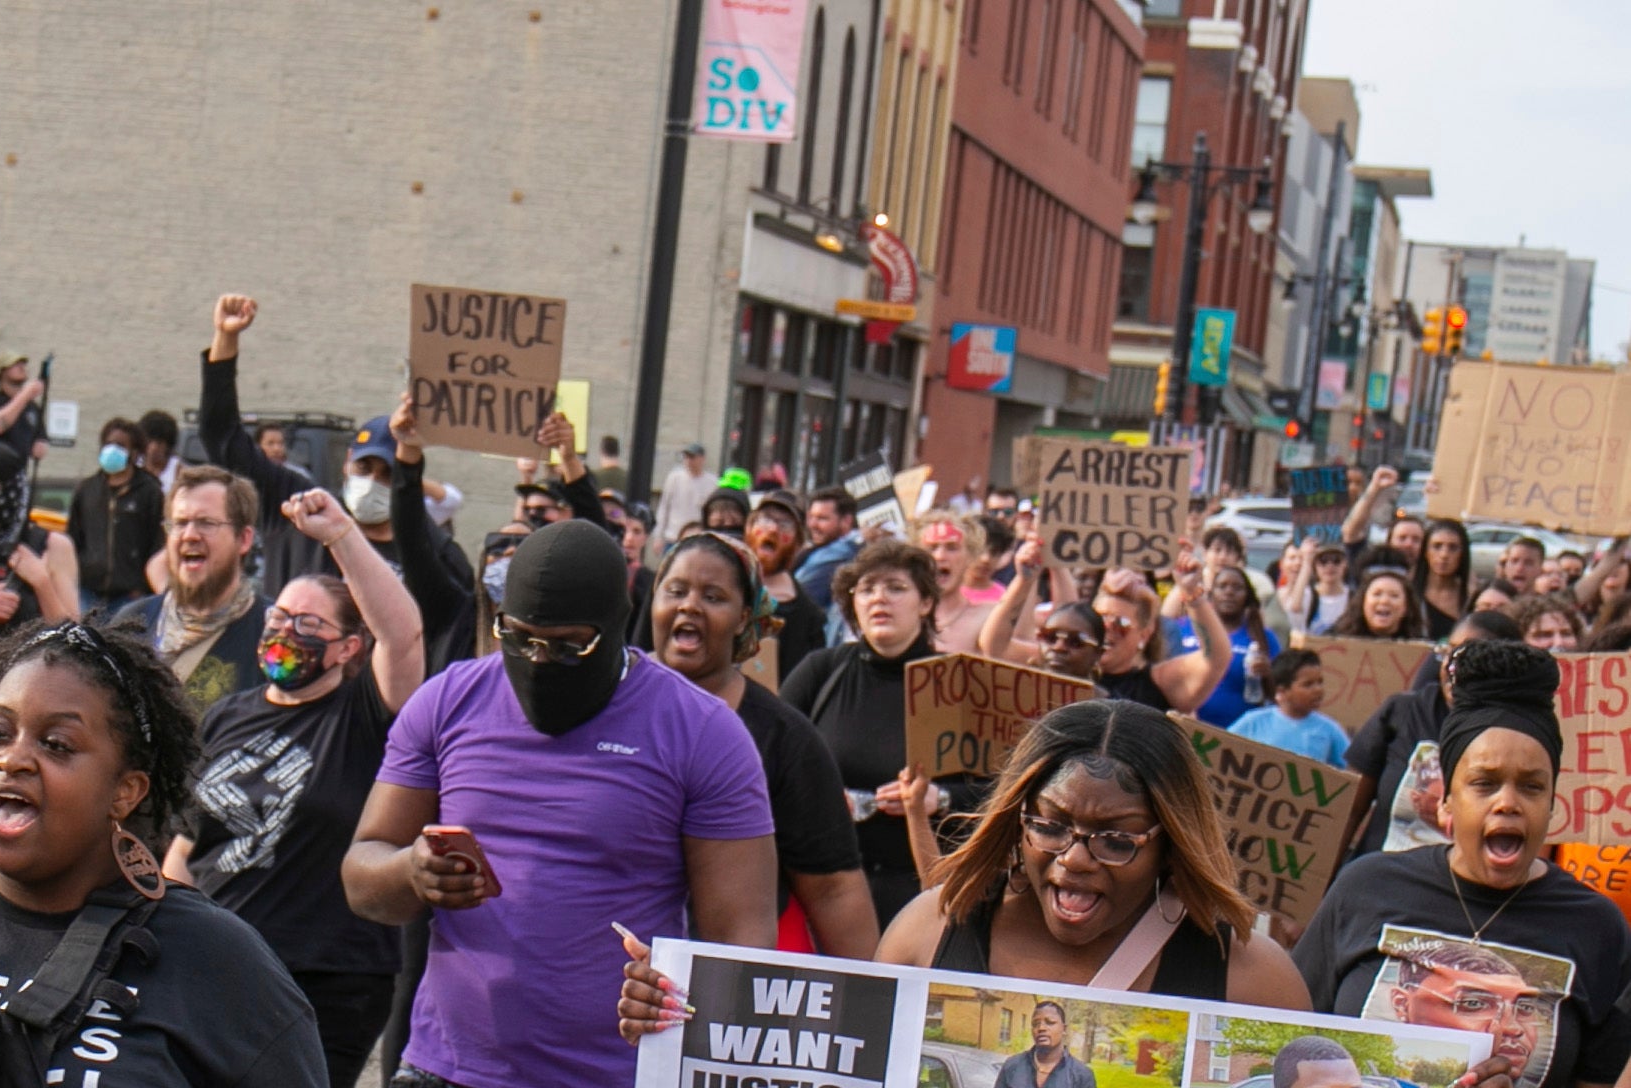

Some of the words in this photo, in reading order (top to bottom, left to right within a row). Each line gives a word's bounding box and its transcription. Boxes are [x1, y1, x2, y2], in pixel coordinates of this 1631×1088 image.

[704, 96, 787, 131] DIV
[422, 292, 562, 349] JUSTICE
[447, 351, 518, 378] FOR
[409, 376, 559, 446] PATRICK
[1497, 378, 1595, 432] NO
[1045, 448, 1189, 493] ARREST
[1503, 455, 1564, 477] NO
[1039, 490, 1178, 534] KILLER
[1051, 529, 1172, 569] COPS
[1192, 730, 1351, 807] KNOW
[753, 976, 834, 1020] WE
[709, 1022, 865, 1075] WANT
